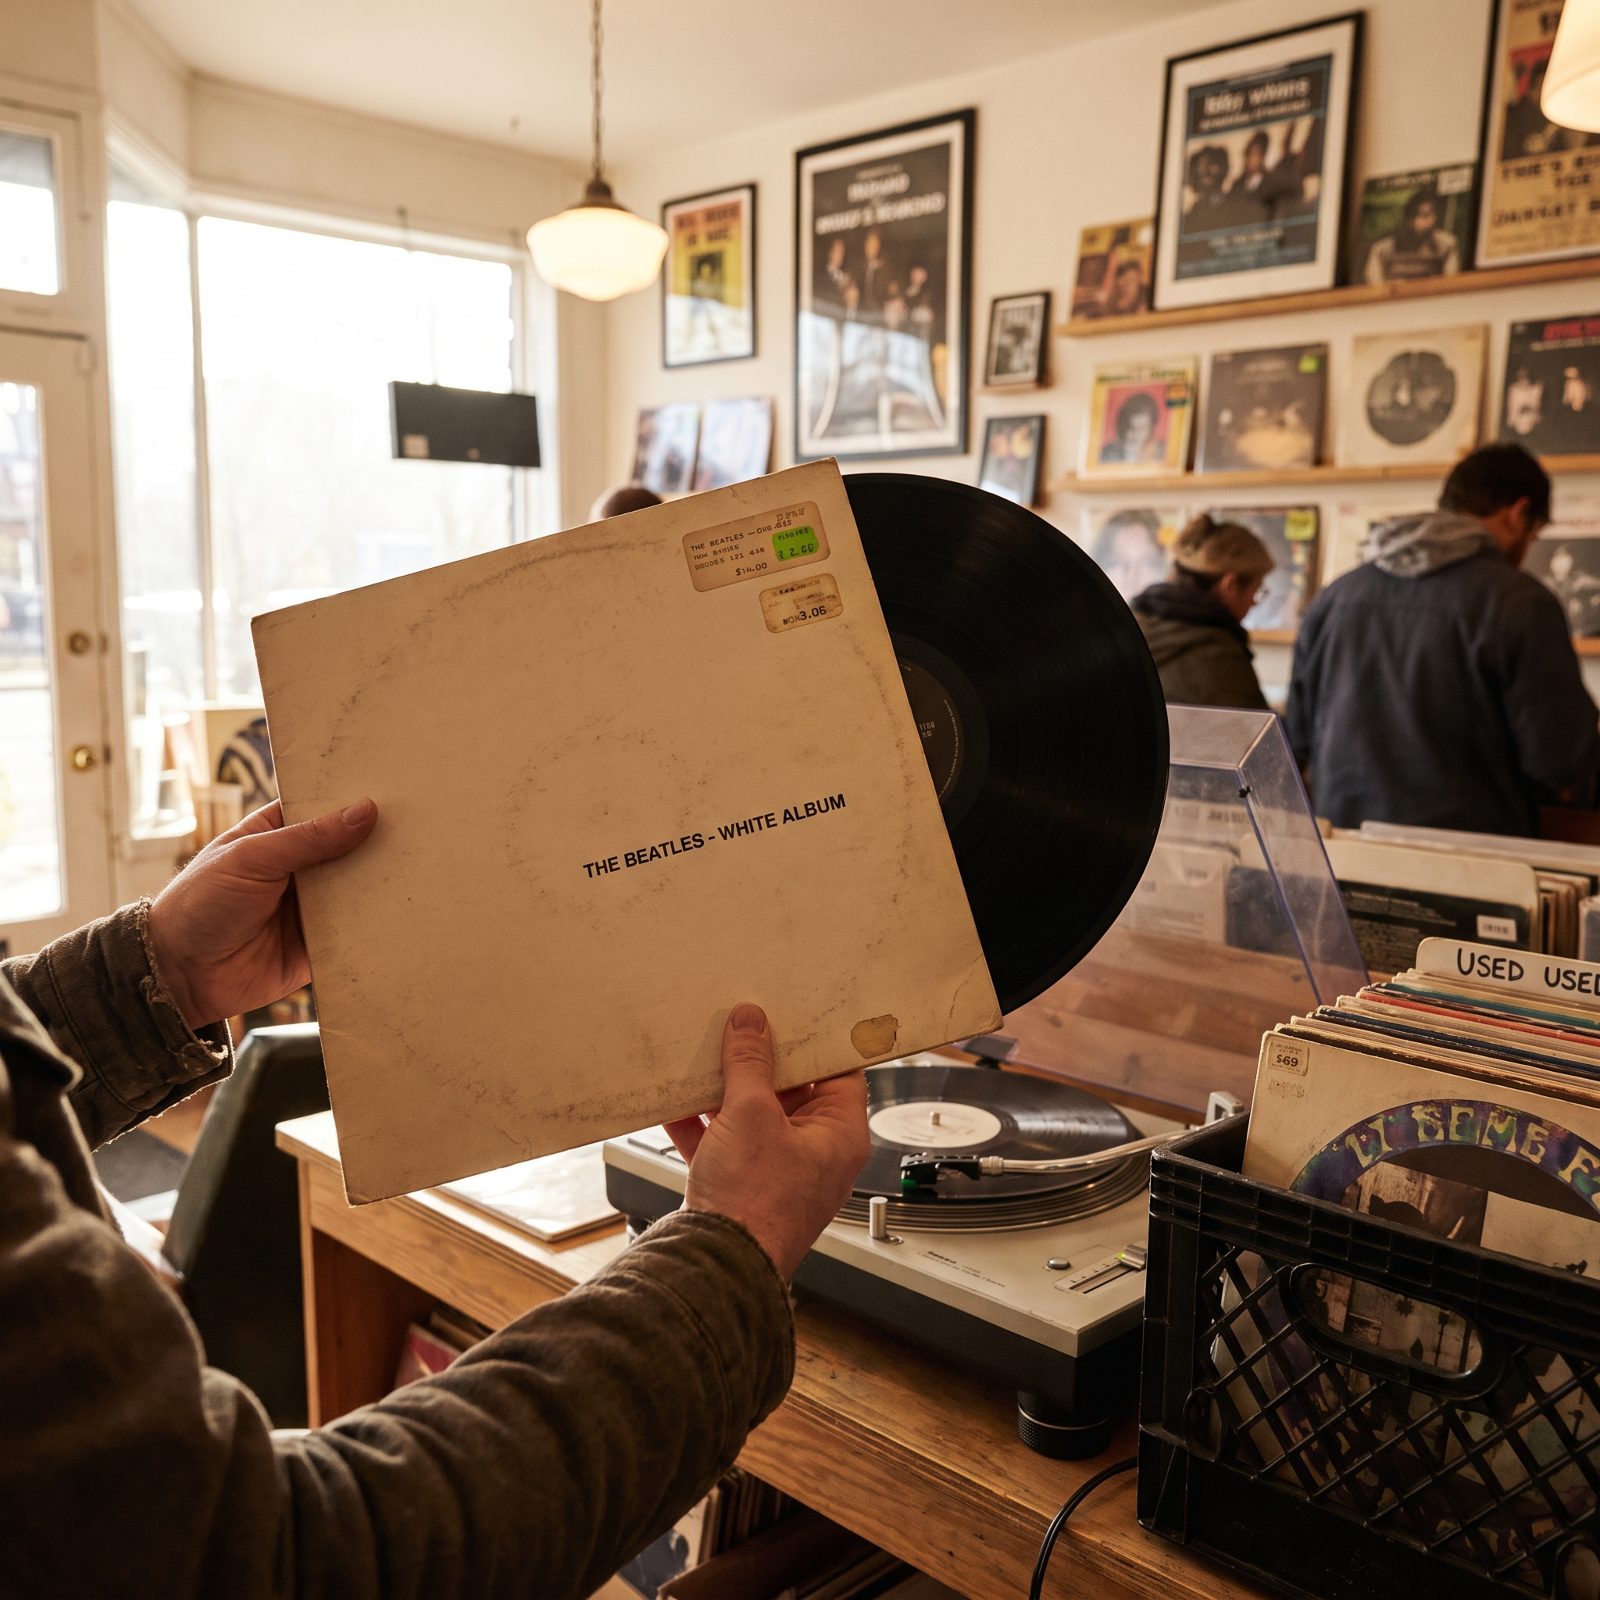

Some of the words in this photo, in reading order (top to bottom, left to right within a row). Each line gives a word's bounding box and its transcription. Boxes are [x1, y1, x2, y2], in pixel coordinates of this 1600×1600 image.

[690, 543, 705, 552] THE
[710, 533, 744, 547] BEATLES
[583, 856, 621, 878] THE
[624, 833, 705, 867] BEATLES
[717, 813, 778, 841] WHITE
[782, 793, 846, 824] ALBUM
[1457, 948, 1525, 981] USED
